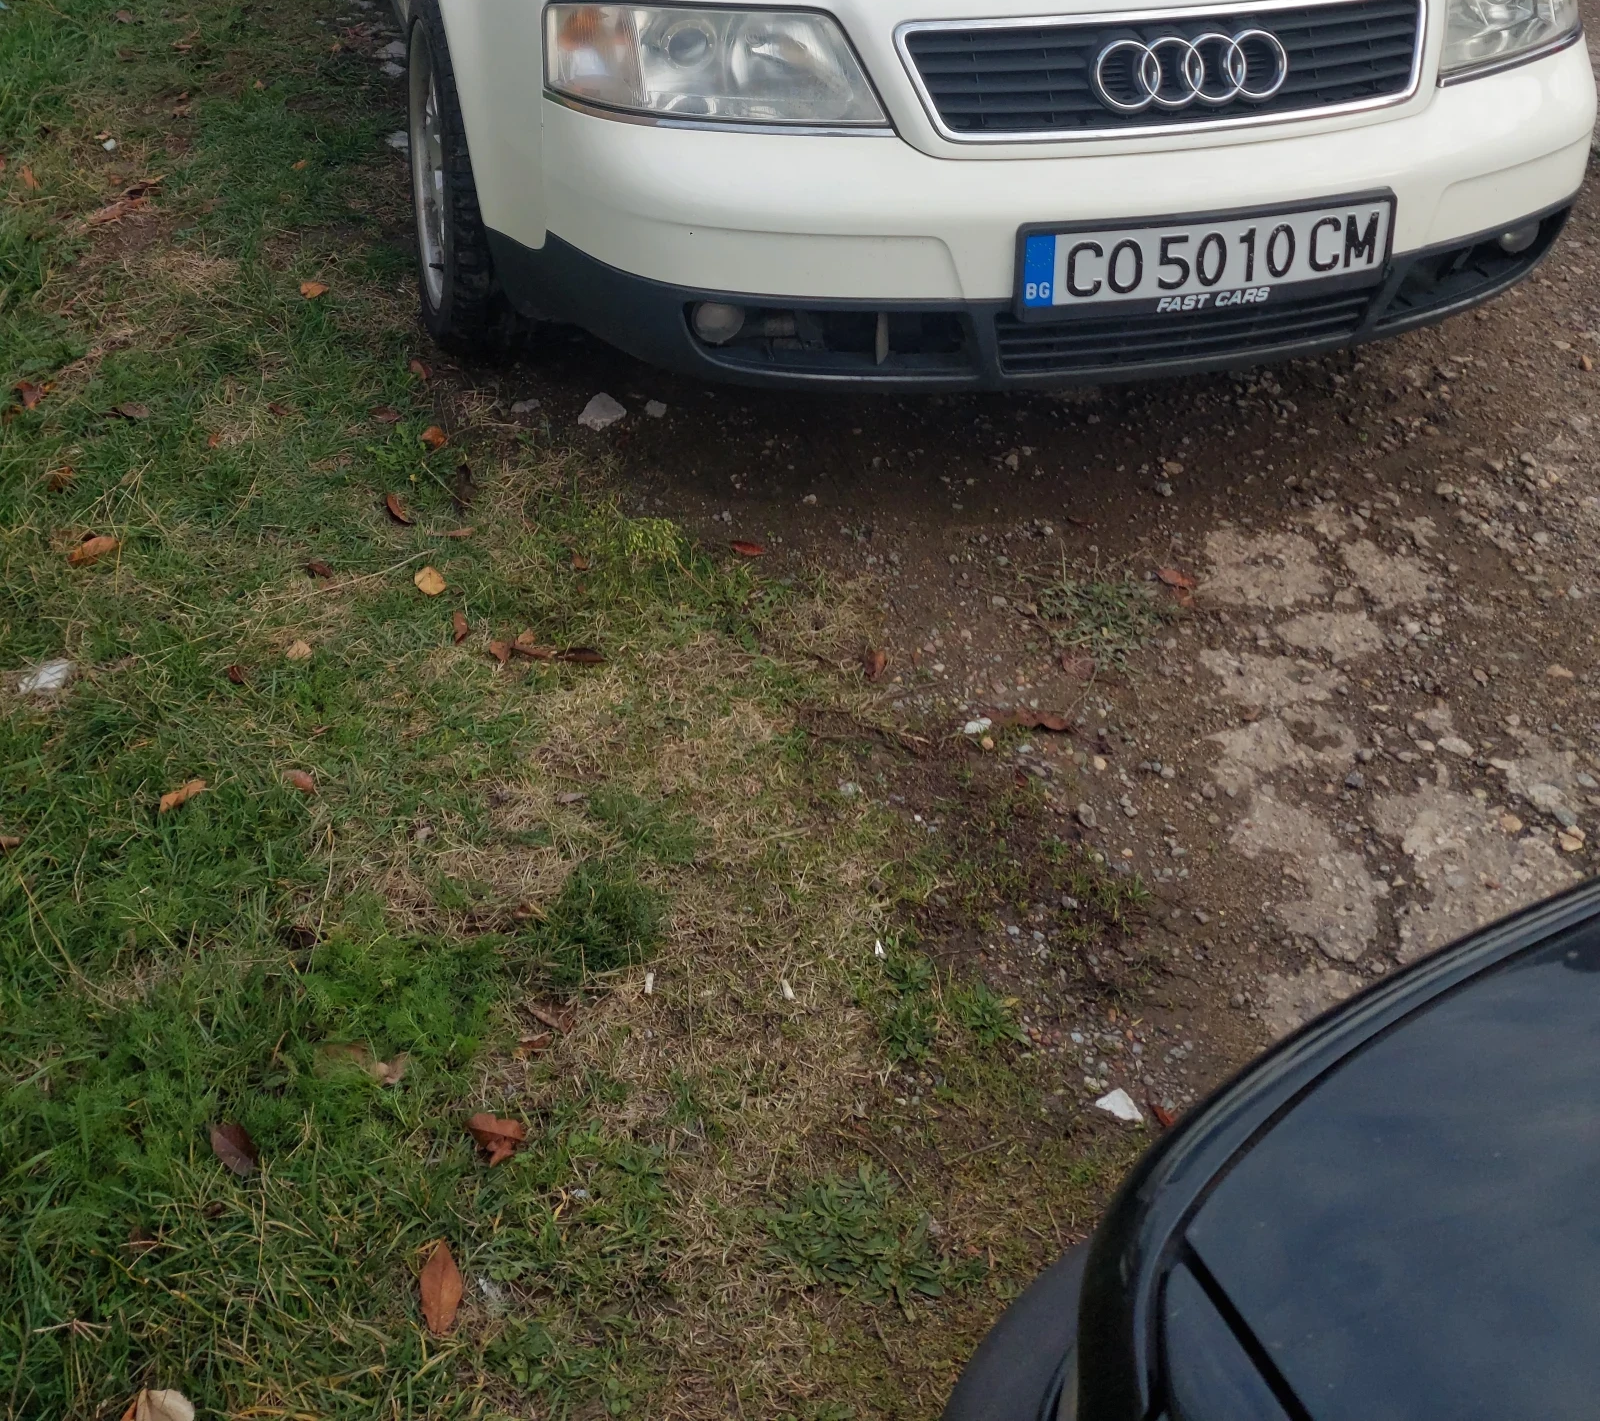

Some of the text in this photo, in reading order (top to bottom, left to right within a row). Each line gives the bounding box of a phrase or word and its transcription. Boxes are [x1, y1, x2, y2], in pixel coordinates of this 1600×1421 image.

[1025, 281, 1051, 300] BG
[1156, 286, 1271, 313] FAST CARS
